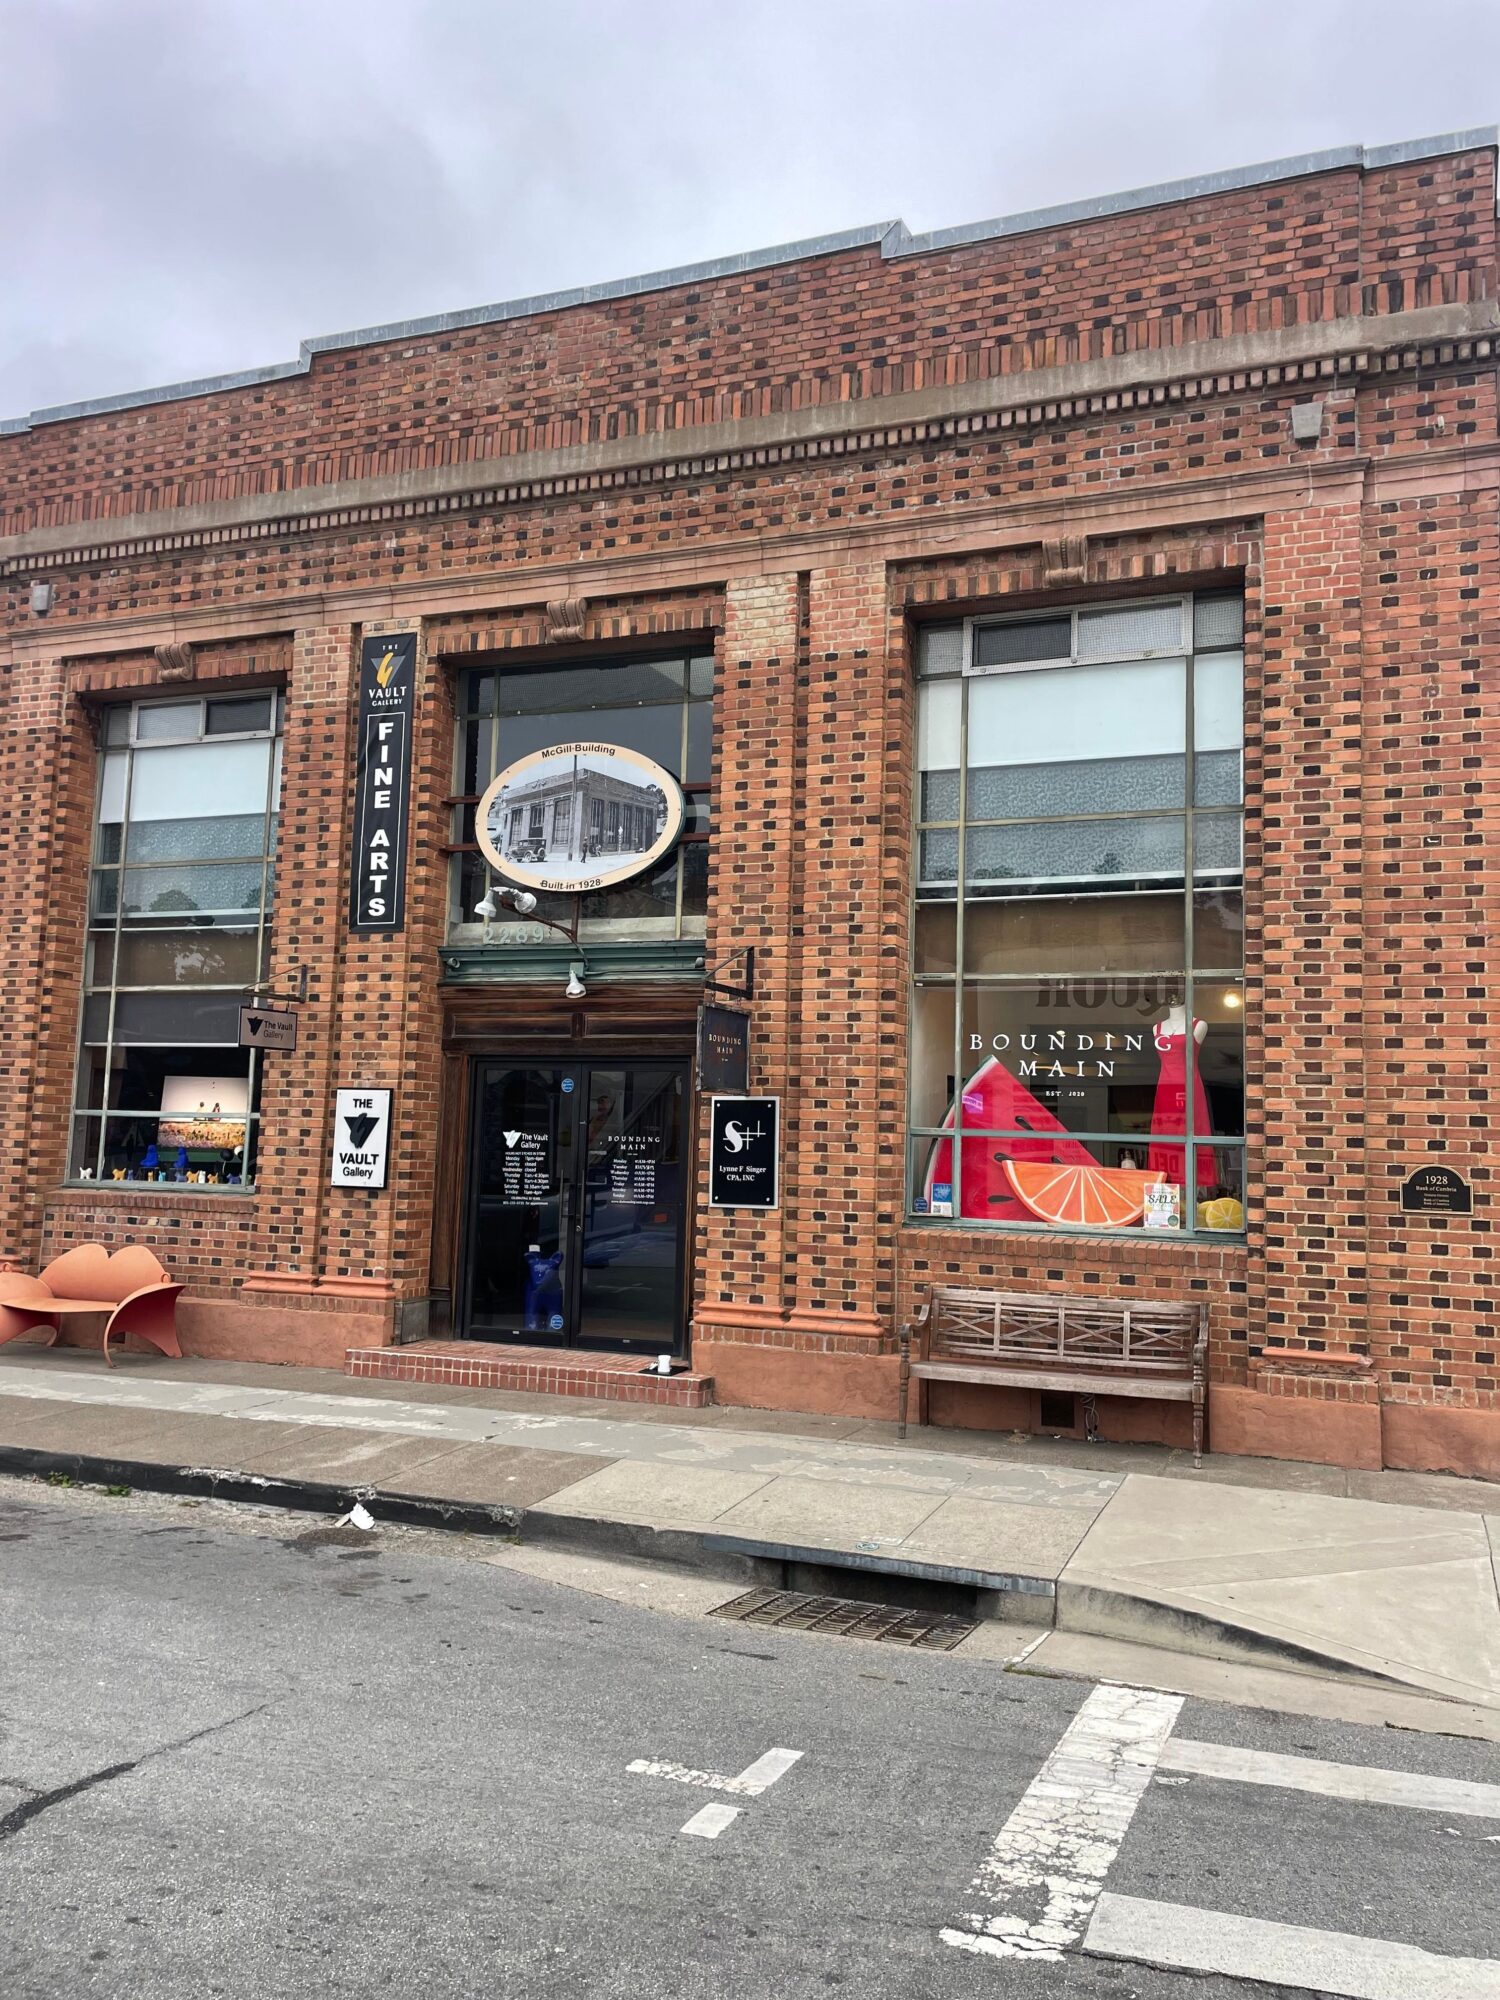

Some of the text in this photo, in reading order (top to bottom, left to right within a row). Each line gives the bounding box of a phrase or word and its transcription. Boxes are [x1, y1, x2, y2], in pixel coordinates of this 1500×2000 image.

[368, 686, 407, 698] VAULT
[541, 744, 616, 758] McGill Building
[373, 722, 394, 808] FINE
[368, 829, 390, 916] ARTS
[579, 878, 601, 888] 1928
[483, 926, 544, 944] 2289
[264, 1021, 293, 1031] The Vault
[263, 1030, 284, 1039] Gallery
[708, 1033, 742, 1045] BOUNDING
[970, 1033, 1172, 1051] BOUNDING
[716, 1046, 733, 1054] MAIN
[1018, 1060, 1116, 1077] MAIN
[353, 1099, 373, 1108] THE
[521, 1141, 541, 1149] Gallery
[339, 1153, 379, 1165] VAULT
[343, 1167, 373, 1179] Gallery
[719, 1165, 738, 1173] Lynne
[746, 1165, 767, 1174] Singer
[1425, 1176, 1448, 1184] 1928
[1148, 1194, 1177, 1204] SALE
